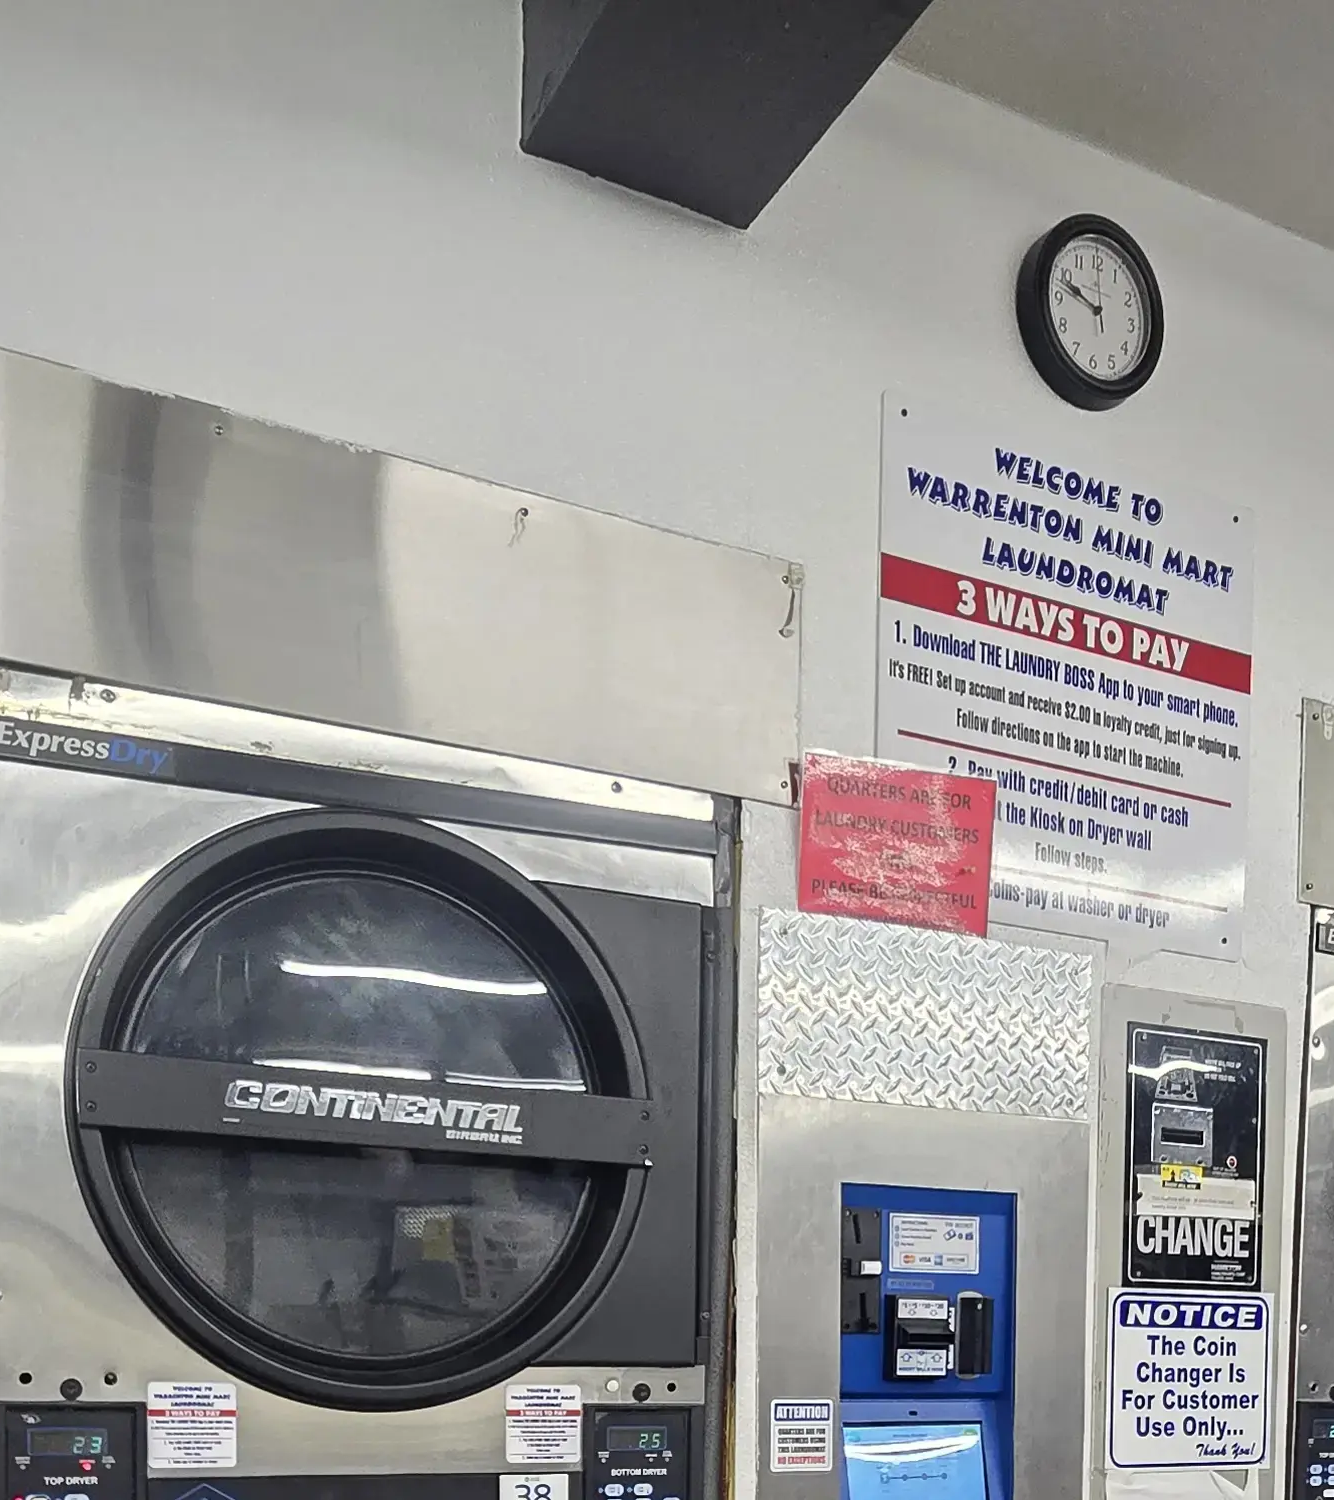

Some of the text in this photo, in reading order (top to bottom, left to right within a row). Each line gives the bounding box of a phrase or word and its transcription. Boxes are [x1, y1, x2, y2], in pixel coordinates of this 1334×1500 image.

[1074, 254, 1084, 271] 11
[1091, 254, 1104, 272] 12
[1060, 267, 1073, 284] 10
[1113, 268, 1118, 285] 1
[1054, 290, 1064, 306] 9
[1123, 291, 1133, 309] 2
[1058, 316, 1068, 334] 8
[1126, 317, 1136, 334] 3
[1071, 340, 1082, 357] 7
[1120, 340, 1129, 356] 4
[1088, 354, 1098, 370] 6
[1107, 354, 1116, 370] 5
[994, 447, 1164, 525] WELCOME TO
[907, 466, 1235, 592] WARRENTON MINI MART
[982, 536, 1170, 617] LAUNDROMAT
[956, 579, 1191, 673] 3 WAYS TO PAY
[894, 620, 1238, 728] 1. Download THE LAUNDRY BOSS App to your smart phone.
[889, 658, 1241, 762] It's FREE! Set up account and receive $2.00 in loyalty credit, just for signing up.
[956, 708, 1184, 778] Follow directions on the app to start the machine.
[996, 769, 1026, 794] with
[1030, 776, 1108, 811] credit/debit
[1111, 794, 1140, 818] card
[1143, 801, 1158, 820] or
[1161, 805, 1190, 828] cash
[816, 809, 886, 833] LAUNDRY
[1006, 801, 1152, 851] the Kiosk on Dryer wall
[1035, 842, 1107, 874] Follow steps.
[1052, 891, 1064, 911] at
[1068, 894, 1115, 919] washer
[1117, 902, 1132, 921] or
[1135, 905, 1170, 929] dryer
[224, 1079, 523, 1133] CONTINENTAL
[1136, 1214, 1250, 1258] CHANGE
[1126, 1303, 1258, 1328] NOTICE
[1147, 1335, 1237, 1356] The Coin
[1136, 1362, 1245, 1388] Changer Is
[1122, 1389, 1259, 1410] For Customer
[776, 1406, 828, 1419] ATTENTION
[1136, 1416, 1244, 1441] Use Only...
[72, 1436, 102, 1454] 23
[639, 1433, 661, 1449] 25
[1196, 1442, 1256, 1459] Thank You!
[43, 1476, 98, 1485] TOP DRYER
[611, 1468, 667, 1476] BOTTOM DRYER
